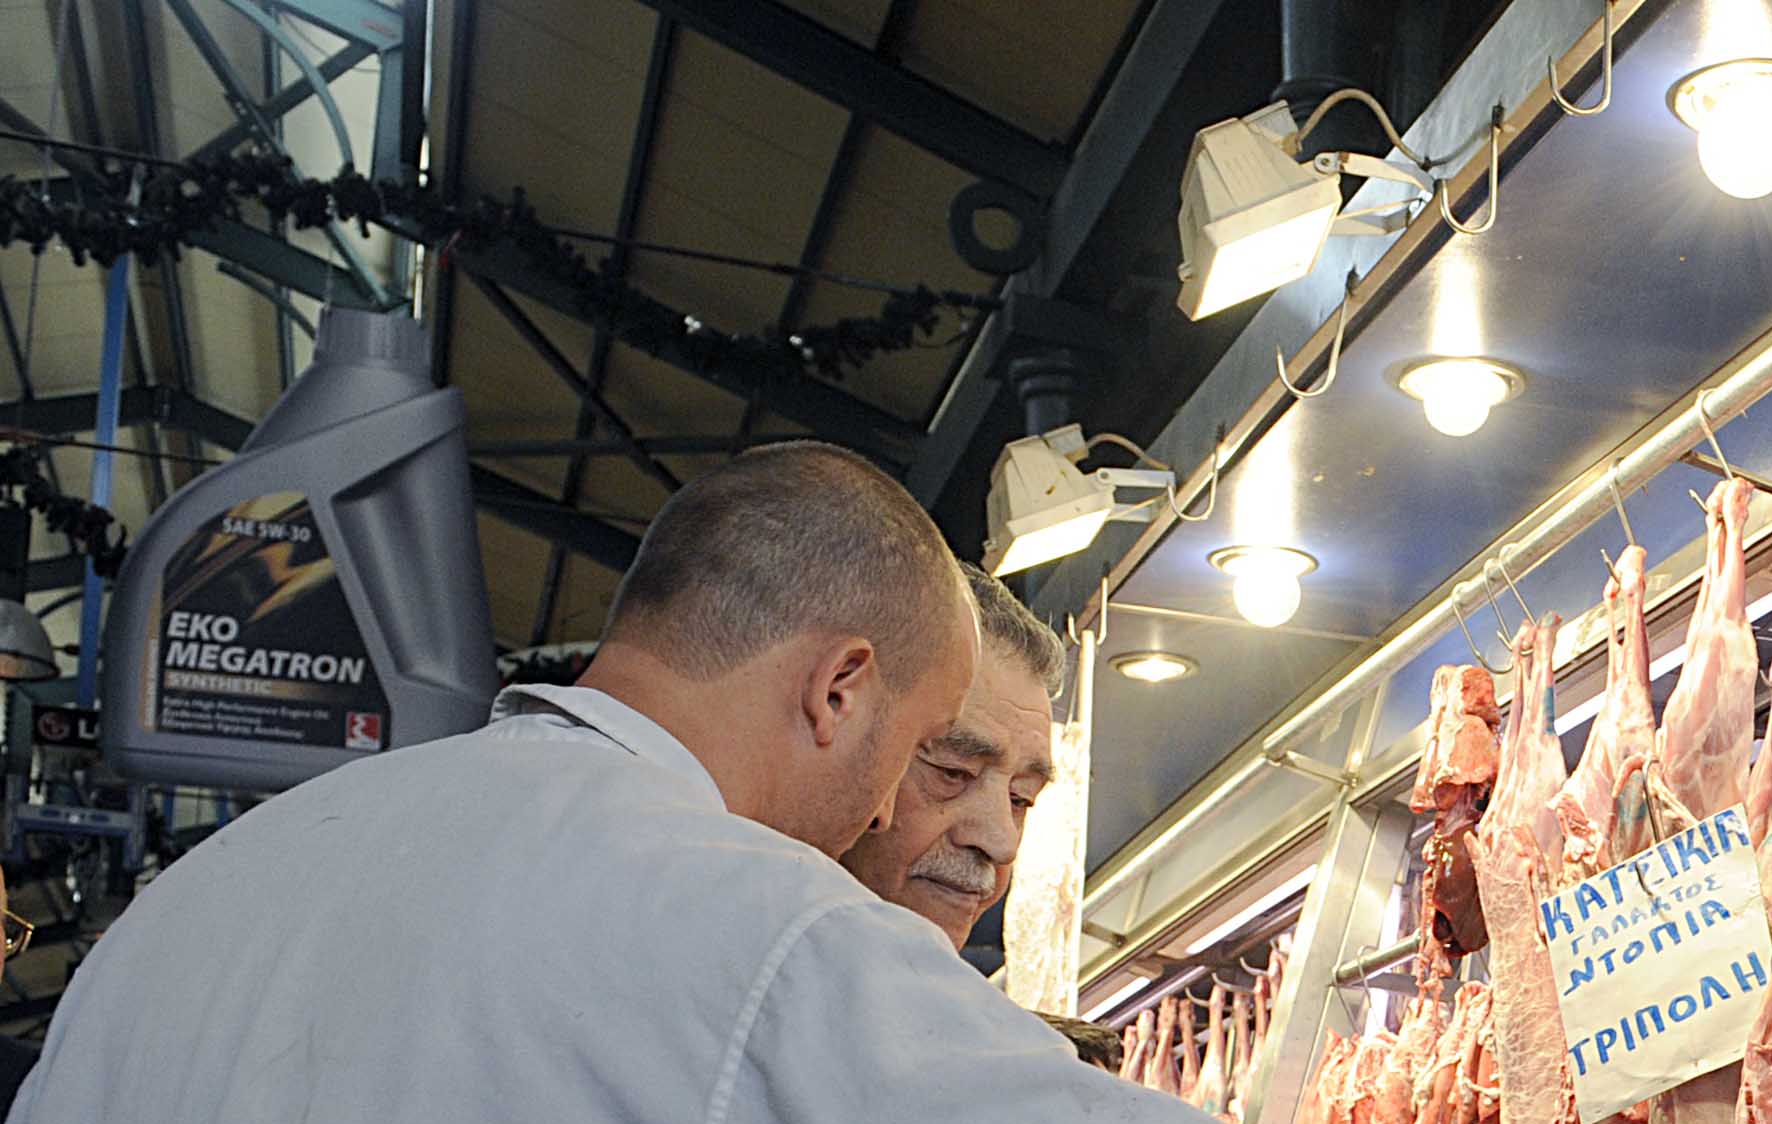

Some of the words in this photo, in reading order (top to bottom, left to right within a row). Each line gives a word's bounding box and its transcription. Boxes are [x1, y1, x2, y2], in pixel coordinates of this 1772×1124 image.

[222, 517, 255, 536] SAE
[257, 520, 312, 543] 5W-30
[167, 611, 238, 642] EKO
[165, 641, 365, 684] MEGATRON
[166, 672, 273, 695] SYNTHETIC
[1563, 899, 1732, 997] ΝΤΟΠΙΑ
[1568, 951, 1768, 1076] ΤΡΙΠΟΛΗ
